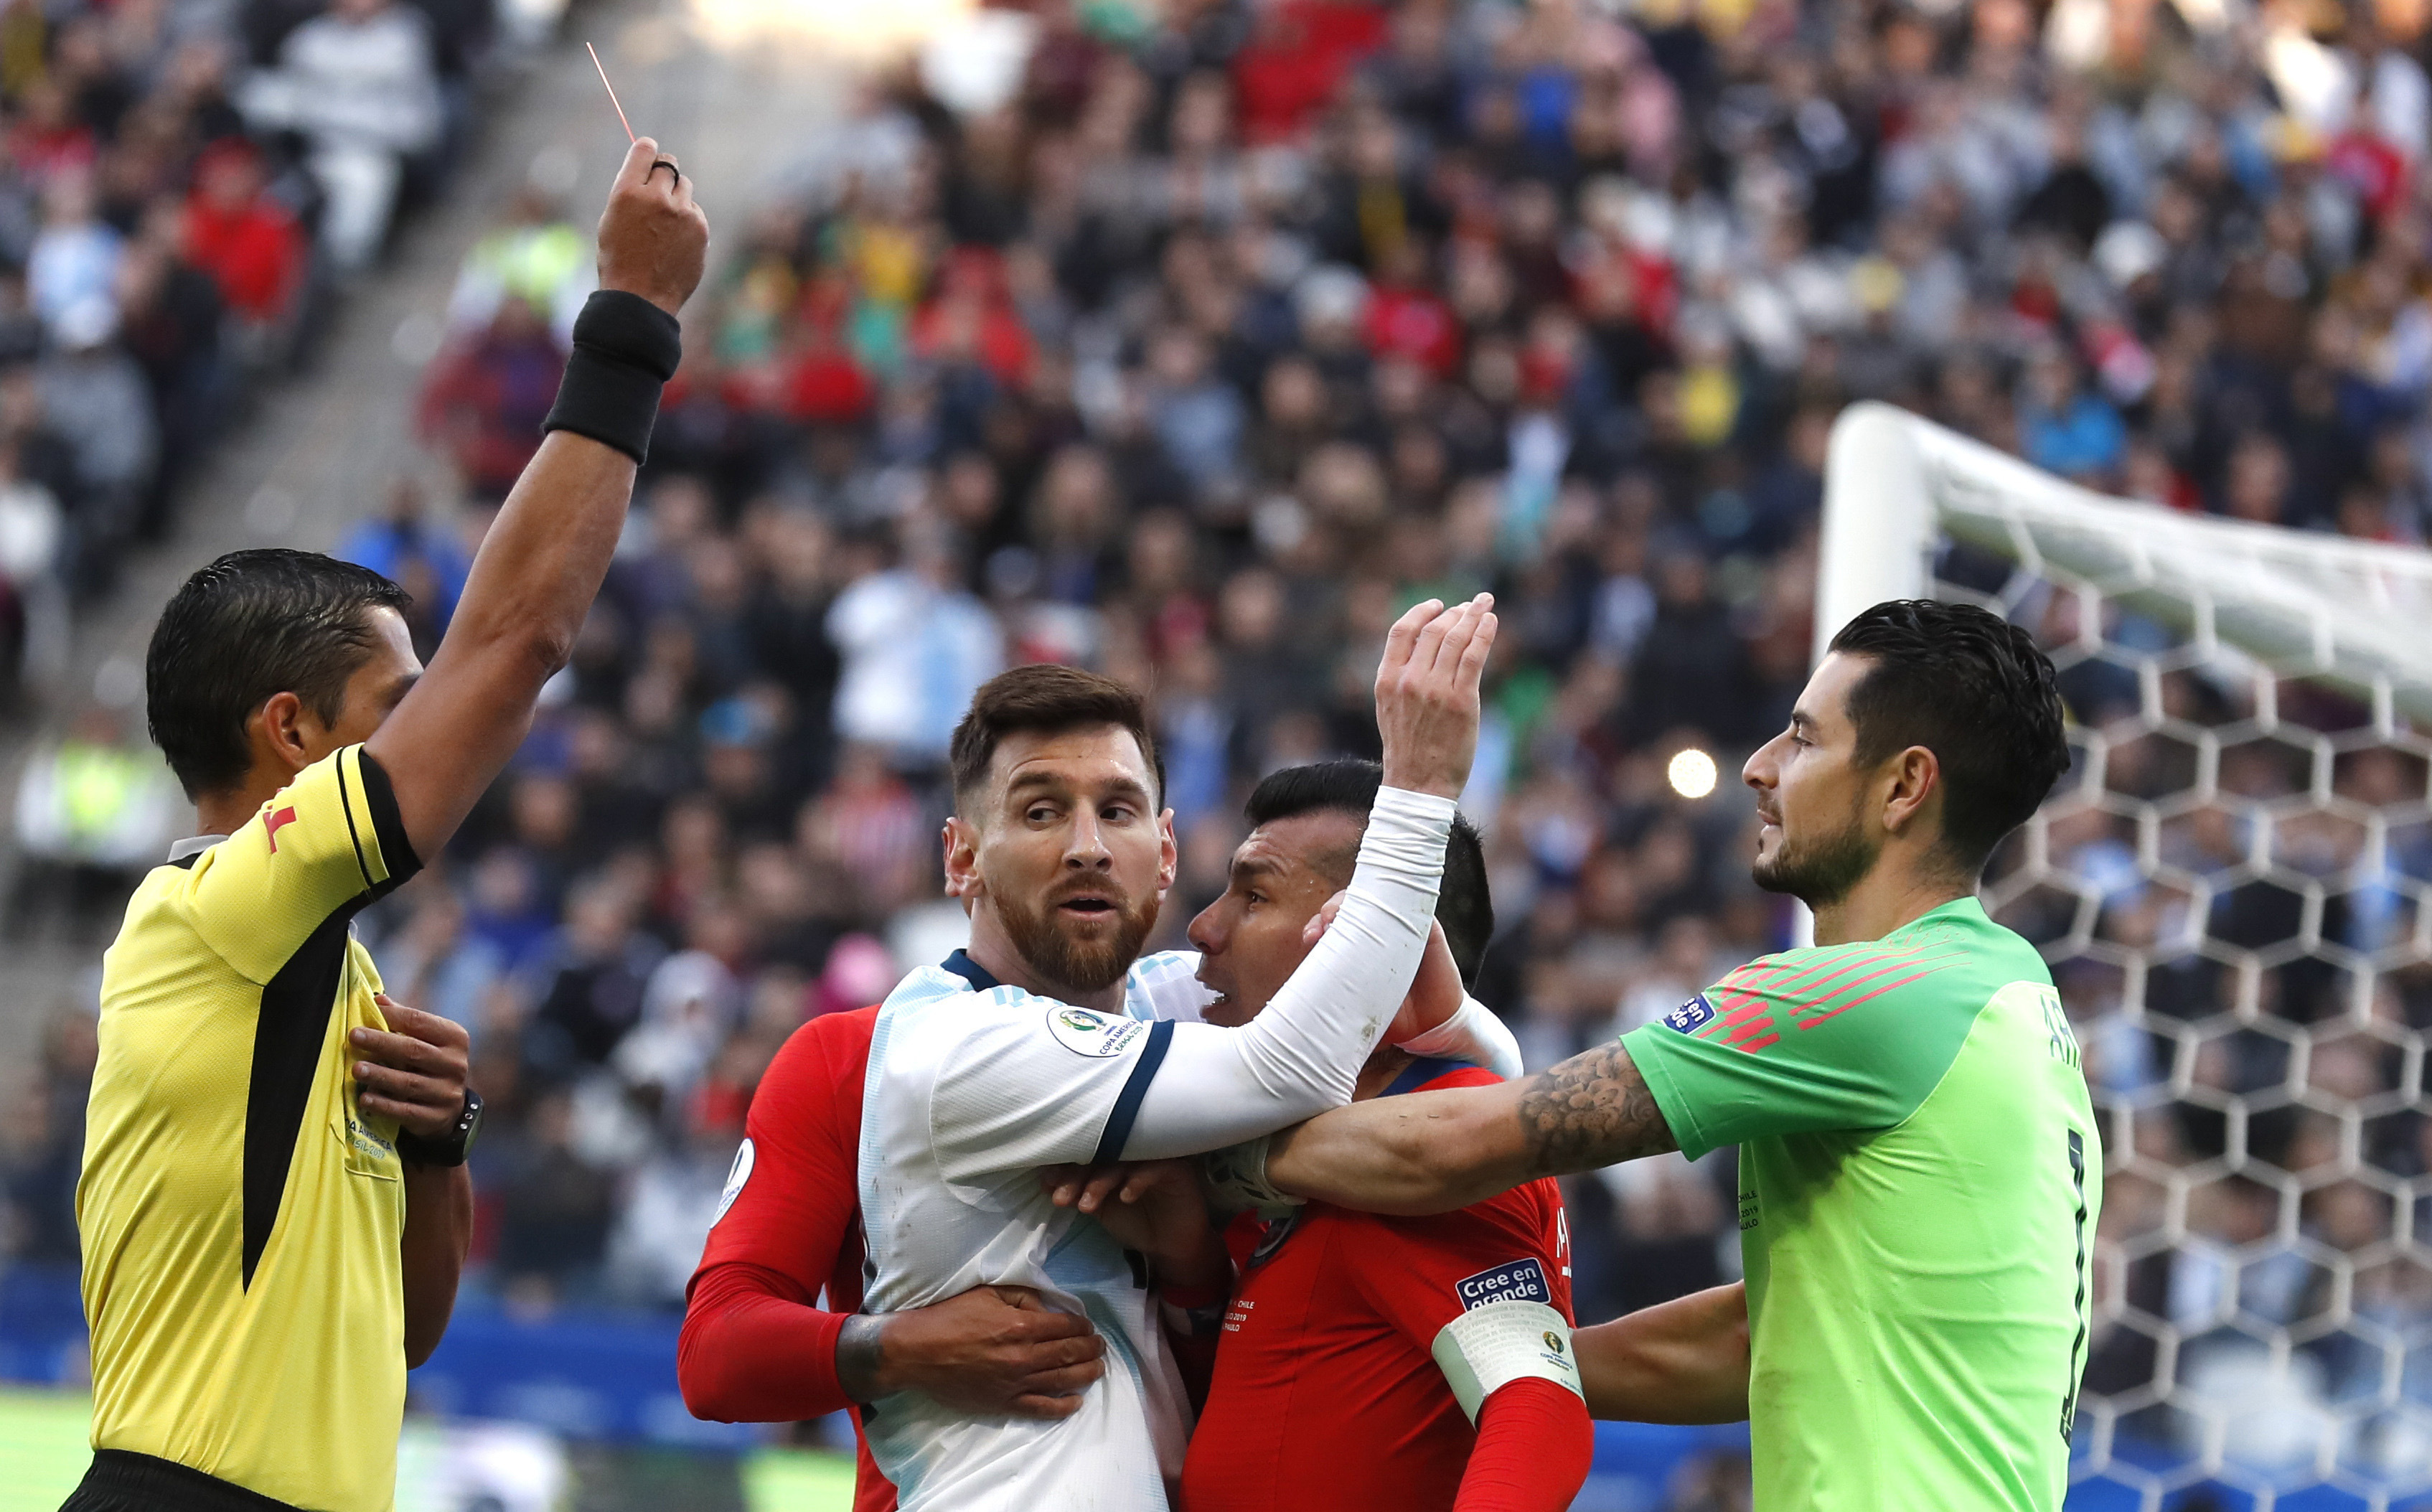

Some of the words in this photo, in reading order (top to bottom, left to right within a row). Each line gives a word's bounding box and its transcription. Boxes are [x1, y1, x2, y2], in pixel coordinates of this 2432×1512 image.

[1099, 1038, 1116, 1055] COPA
[1741, 1206, 1758, 1218] 2019
[1463, 1273, 1510, 1297] Cree
[1513, 1267, 1537, 1282] en
[1238, 1300, 1254, 1309] CHILE
[1234, 1313, 1247, 1322] 2019
